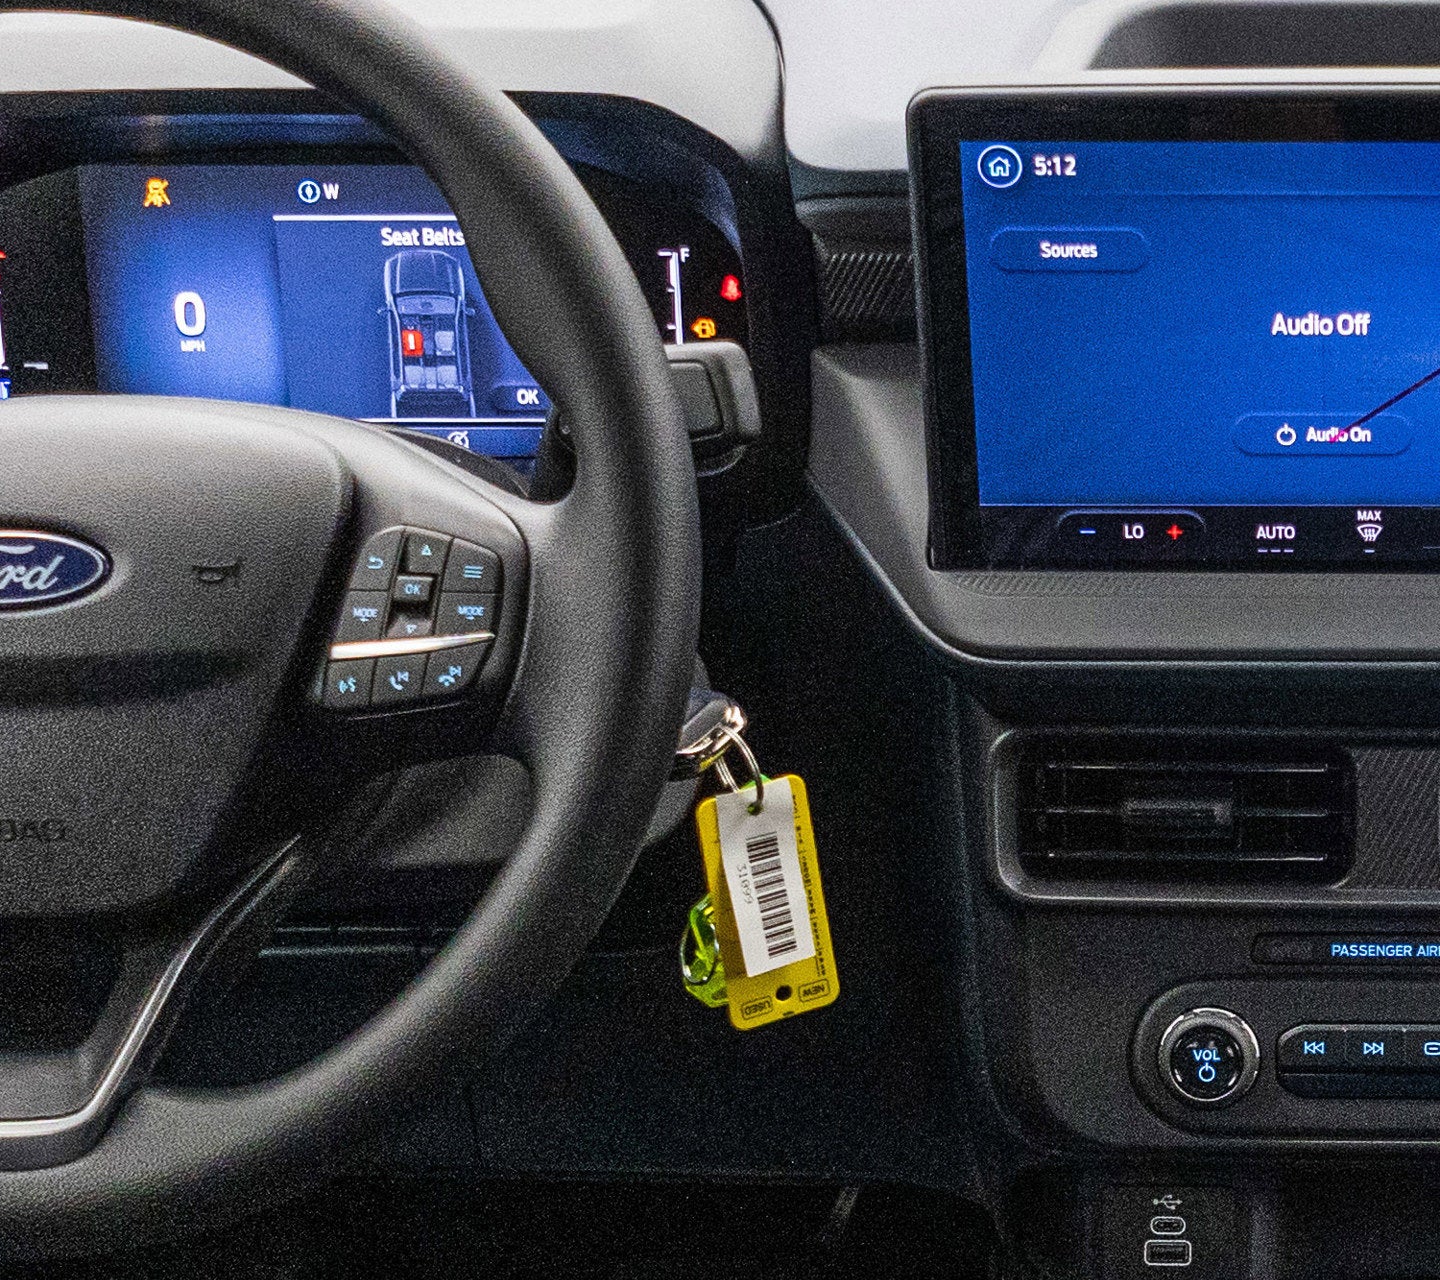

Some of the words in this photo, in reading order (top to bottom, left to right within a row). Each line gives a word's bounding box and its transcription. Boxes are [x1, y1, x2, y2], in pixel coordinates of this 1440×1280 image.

[1032, 154, 1078, 178] 5:12
[323, 182, 339, 200] W
[380, 227, 420, 247] Seat
[422, 227, 465, 247] Belts
[680, 247, 690, 263] F
[1039, 241, 1099, 260] Sources
[174, 291, 206, 337] 0
[1270, 312, 1334, 336] Audio
[1336, 312, 1372, 336] Off
[180, 340, 206, 352] MPH
[516, 387, 540, 406] OK
[1305, 426, 1349, 443] Audio
[1350, 427, 1372, 443] On
[1356, 510, 1382, 522] MAX
[1123, 523, 1145, 541] LO
[1256, 523, 1296, 541] AUTO
[404, 583, 421, 596] OK
[352, 606, 378, 618] MODE
[458, 605, 486, 617] MODE
[1330, 943, 1413, 958] PASSENGER
[801, 982, 826, 999] NEW
[745, 997, 772, 1016] USED
[1193, 1049, 1221, 1062] VOL
